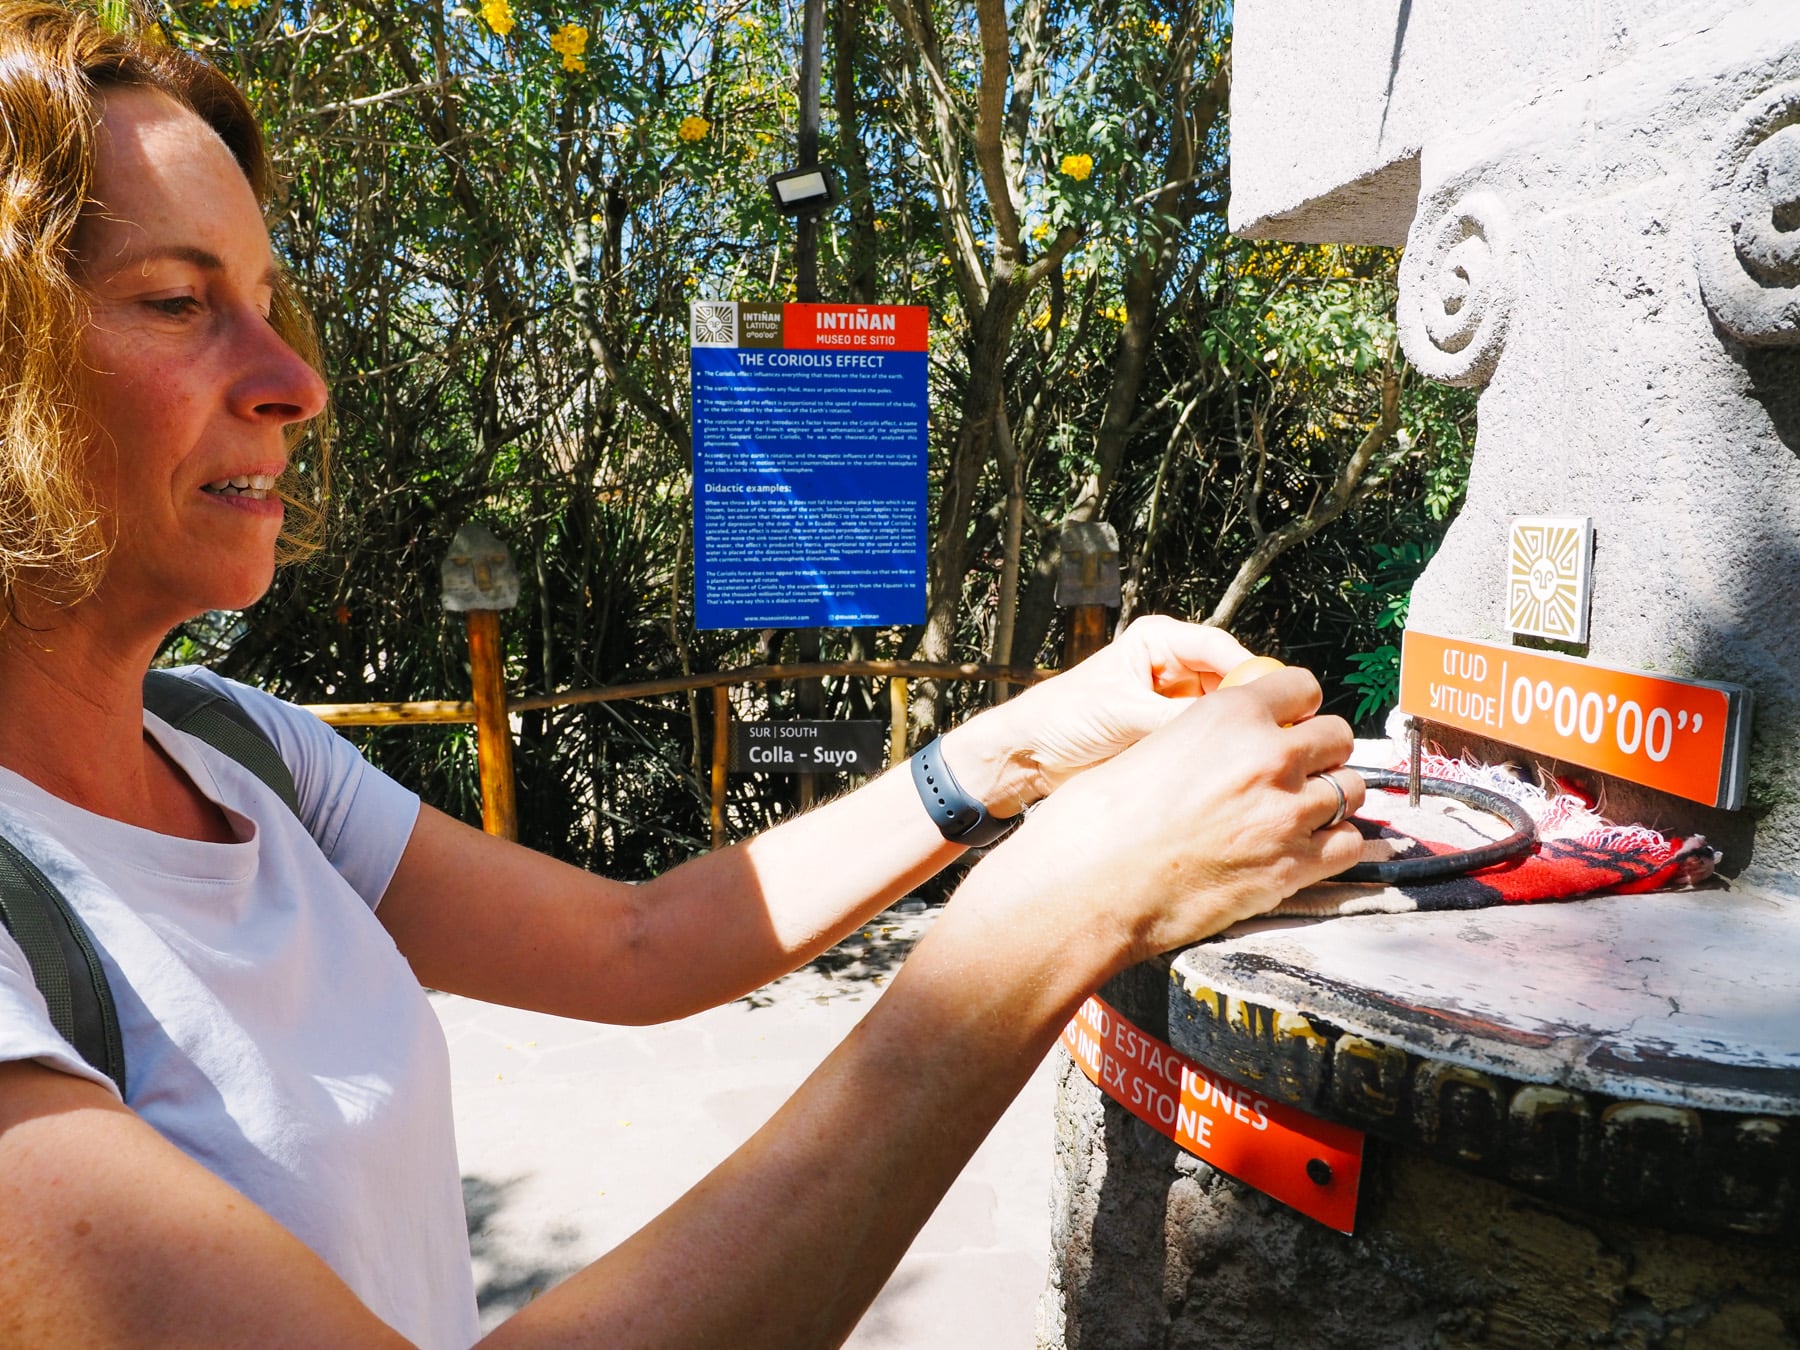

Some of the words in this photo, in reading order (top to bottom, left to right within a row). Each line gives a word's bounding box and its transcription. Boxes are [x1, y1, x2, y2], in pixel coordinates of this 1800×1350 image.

[743, 311, 780, 322] INTIÑAN
[816, 308, 896, 330] INTIÑAN
[816, 335, 850, 345] MUSEO
[854, 335, 867, 345] DE
[870, 336, 895, 345] SITIO
[738, 353, 764, 366] THE
[768, 354, 832, 367] CORIOLIS
[836, 355, 885, 368] EFFECT
[704, 483, 744, 492] Didactic
[746, 484, 792, 494] examples:
[750, 727, 771, 737] SUR
[780, 727, 818, 737] SOUTH
[749, 746, 794, 763] Colla
[814, 746, 858, 767] Suyo
[1114, 1021, 1269, 1131] ESTACIONES
[1078, 1028, 1128, 1094] INDEX
[1132, 1077, 1214, 1148] STONE
